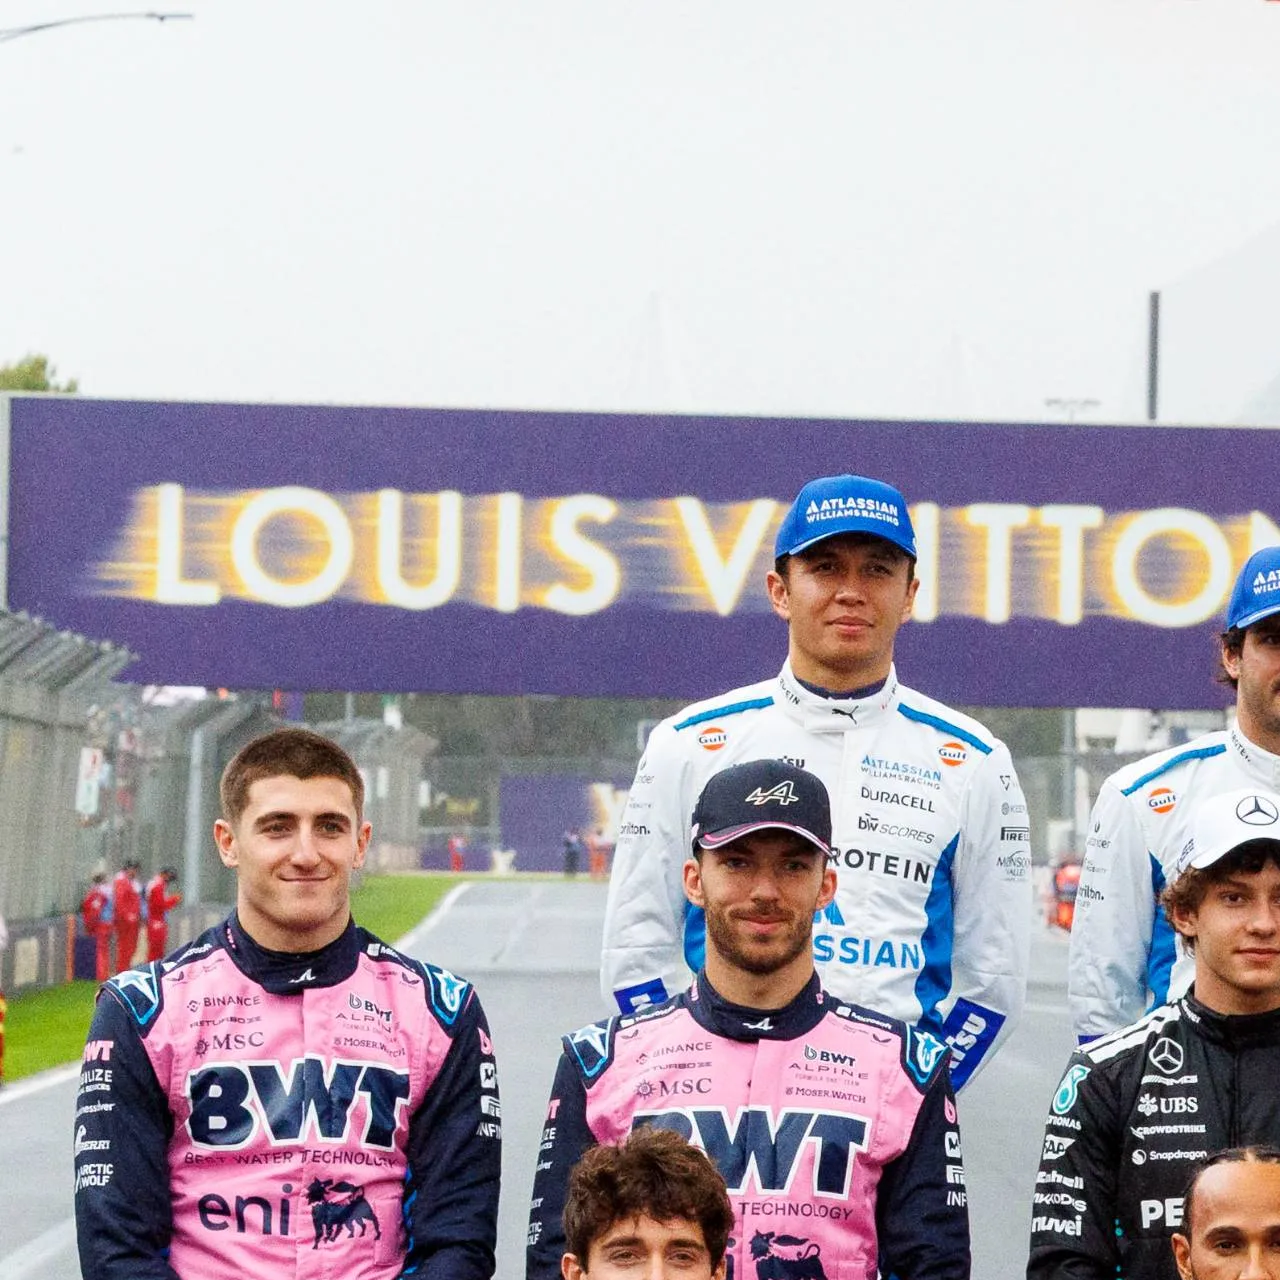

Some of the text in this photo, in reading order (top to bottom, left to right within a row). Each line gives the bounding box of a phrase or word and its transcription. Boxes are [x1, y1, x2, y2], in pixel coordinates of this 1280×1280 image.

[820, 497, 898, 517] ATLASSIAN
[806, 508, 861, 524] WILLIAMS
[153, 482, 623, 616] LOUIS
[698, 734, 727, 746] Gulf
[938, 746, 967, 759] Gulf
[861, 787, 935, 813] DURACELL
[1148, 795, 1176, 808] Gulf
[204, 995, 261, 1008] BINANCE
[212, 1032, 264, 1049] MSC
[653, 1041, 713, 1058] BINANCE
[820, 1051, 856, 1067] BWT
[788, 1063, 869, 1080] ALPINE
[659, 1077, 713, 1098] MSC
[185, 1054, 412, 1152] BWT
[1160, 1097, 1199, 1114] UBS
[1136, 1124, 1206, 1136] CROWDSTRIKE
[234, 1151, 293, 1165] WATER
[1149, 1149, 1207, 1163] Snapdragon
[200, 1183, 292, 1236] eni
[738, 1202, 854, 1221] TECHNOLOGY
